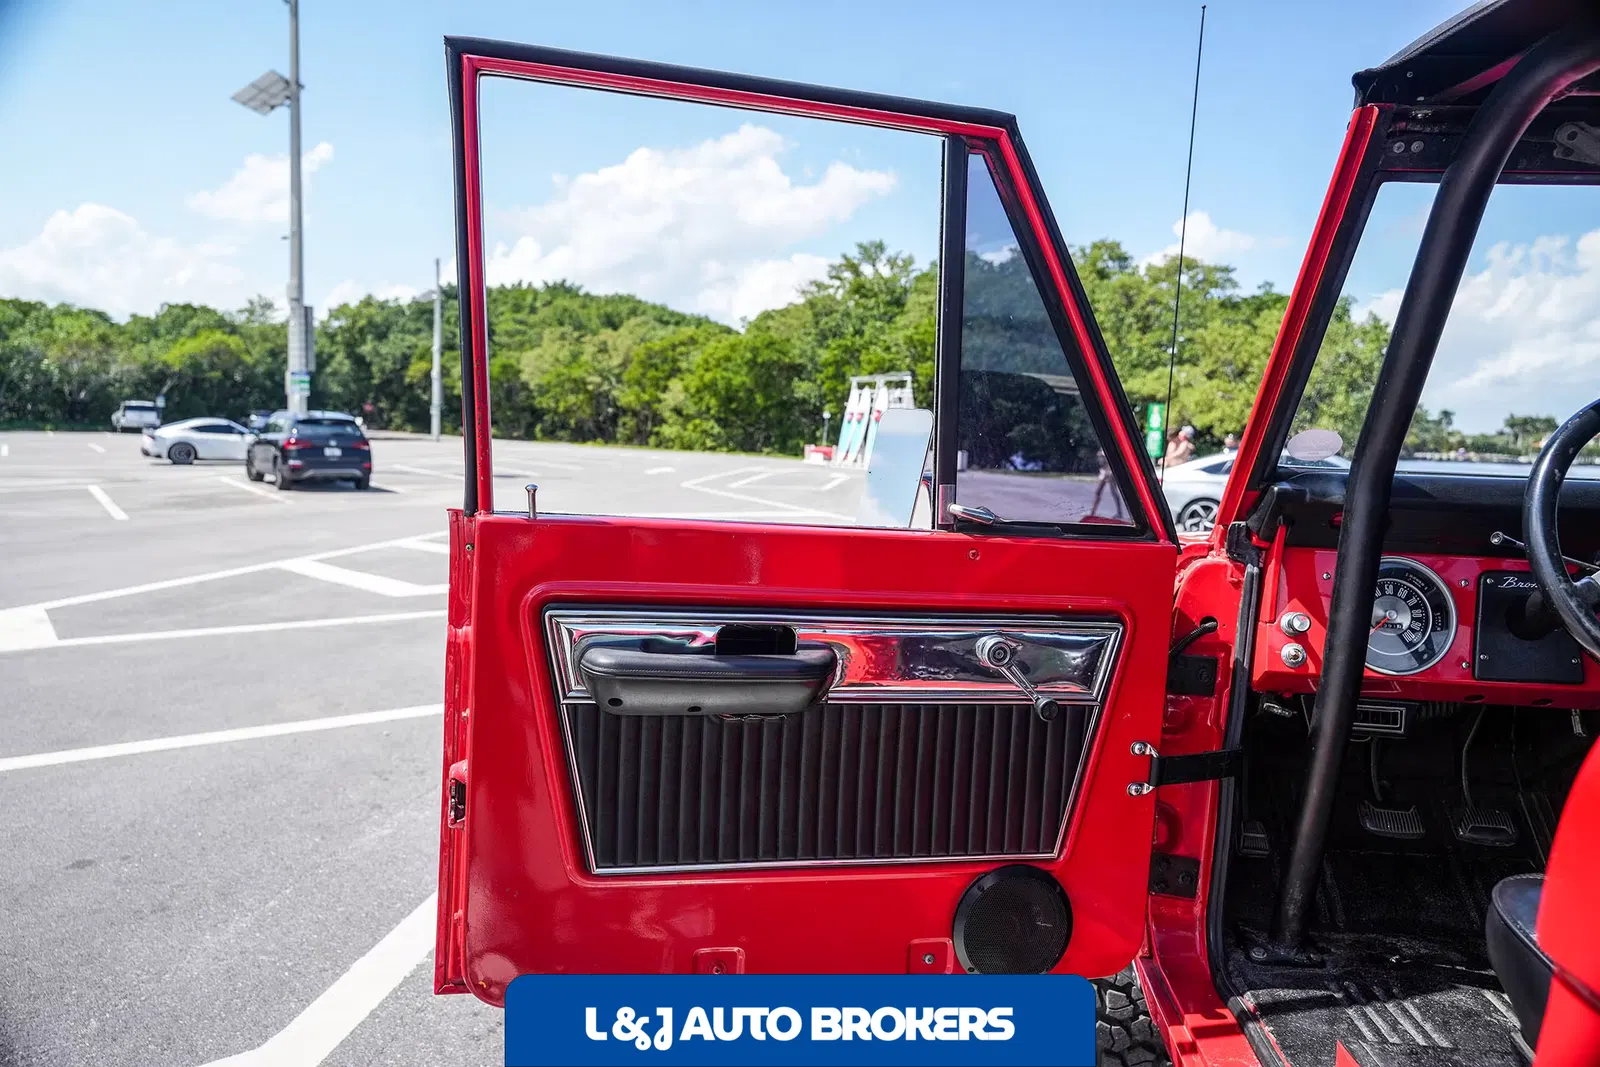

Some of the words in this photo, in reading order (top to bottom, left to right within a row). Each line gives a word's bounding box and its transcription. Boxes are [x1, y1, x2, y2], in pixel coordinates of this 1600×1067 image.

[1385, 584, 1393, 594] 50
[1397, 587, 1408, 598] 60
[1406, 596, 1417, 606] 70
[1412, 609, 1422, 617] 80
[1402, 629, 1415, 642] 100
